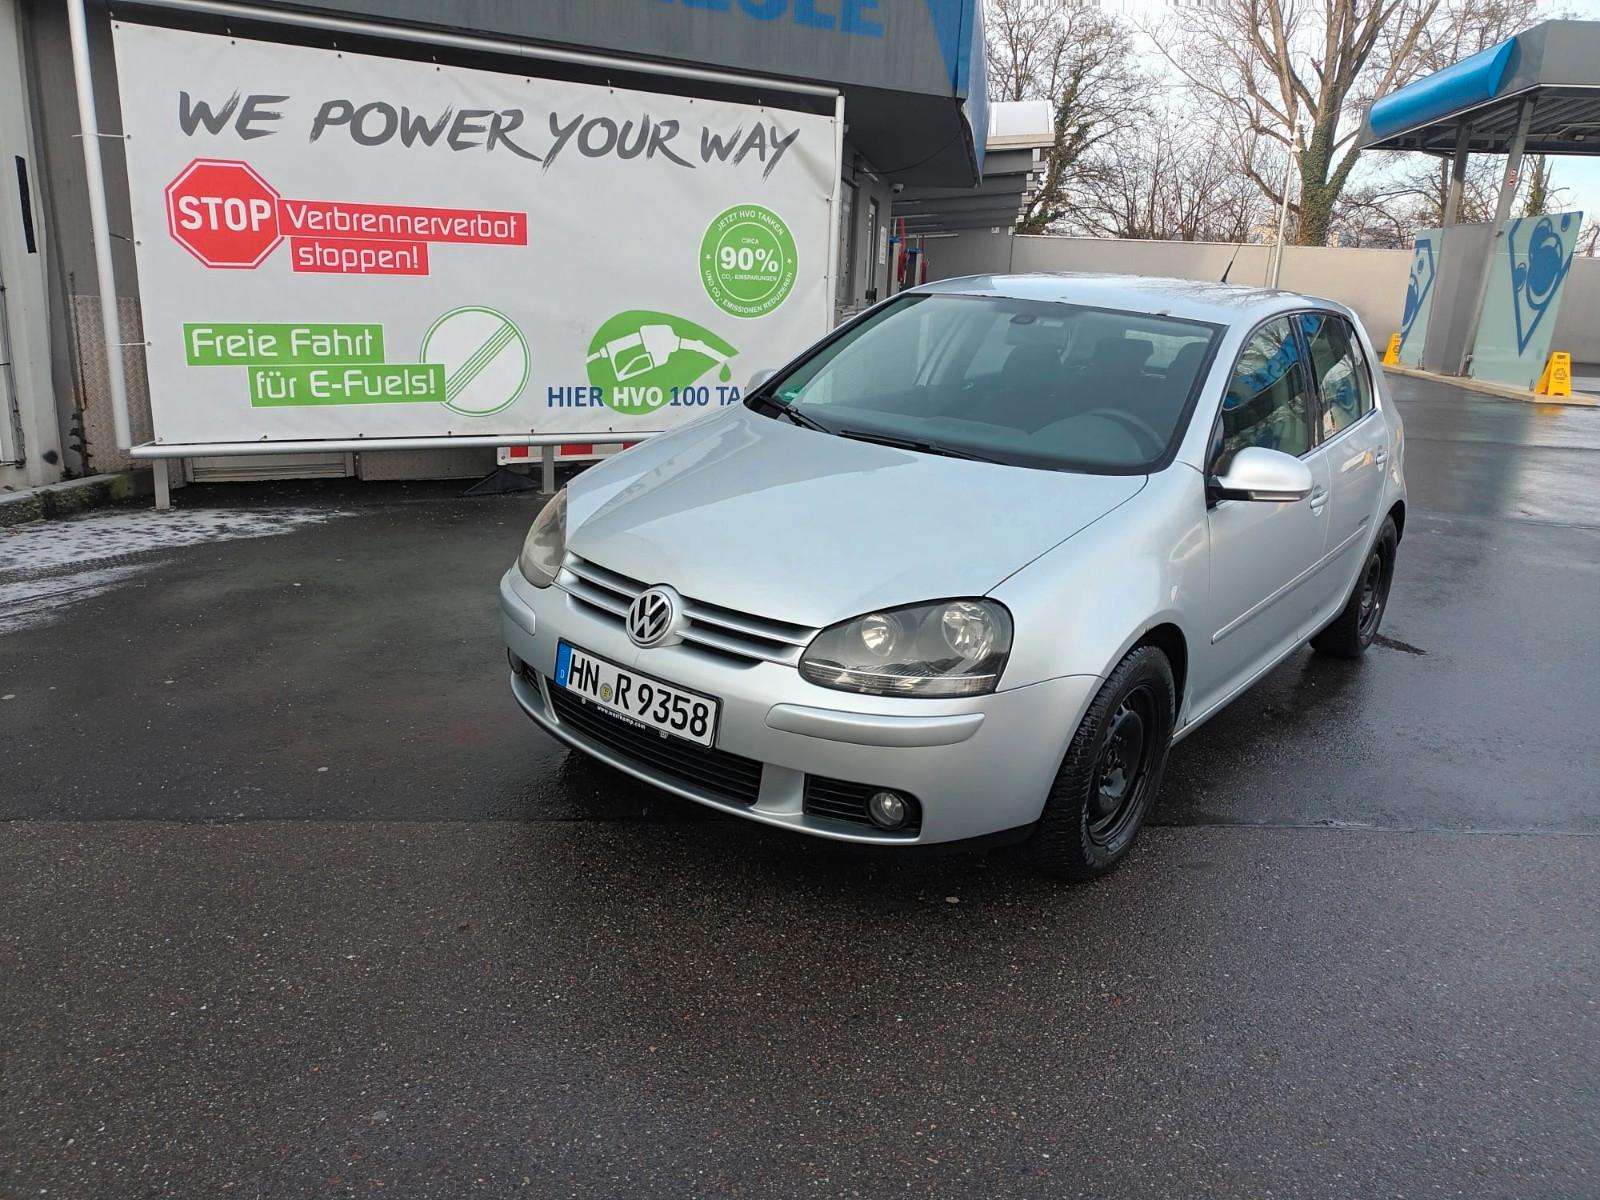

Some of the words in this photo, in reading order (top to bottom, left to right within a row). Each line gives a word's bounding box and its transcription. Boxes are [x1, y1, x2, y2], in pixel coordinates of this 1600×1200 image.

[179, 87, 290, 141] WE
[309, 99, 543, 162] POWER
[541, 111, 696, 176] YOUR
[700, 121, 800, 184] WAY
[178, 195, 271, 231] STOP
[286, 204, 518, 239] Verbrennerverbot
[718, 212, 738, 231] JETZT
[739, 210, 756, 218] HVO
[757, 211, 785, 236] TANKEN
[298, 242, 419, 272] stoppen!
[720, 246, 779, 273] 90%
[705, 270, 715, 287] UND
[763, 272, 792, 309] REDUZIEREN
[191, 328, 278, 358] Freie
[290, 328, 373, 357] Fahrt
[256, 370, 298, 400] für
[310, 369, 436, 398] E-Fuels!
[547, 386, 604, 408] HIER
[613, 386, 663, 407] HVO
[670, 386, 709, 407] 100
[716, 386, 741, 406] TA
[568, 653, 600, 697] HN
[614, 673, 632, 710] R
[637, 683, 709, 737] 9358
